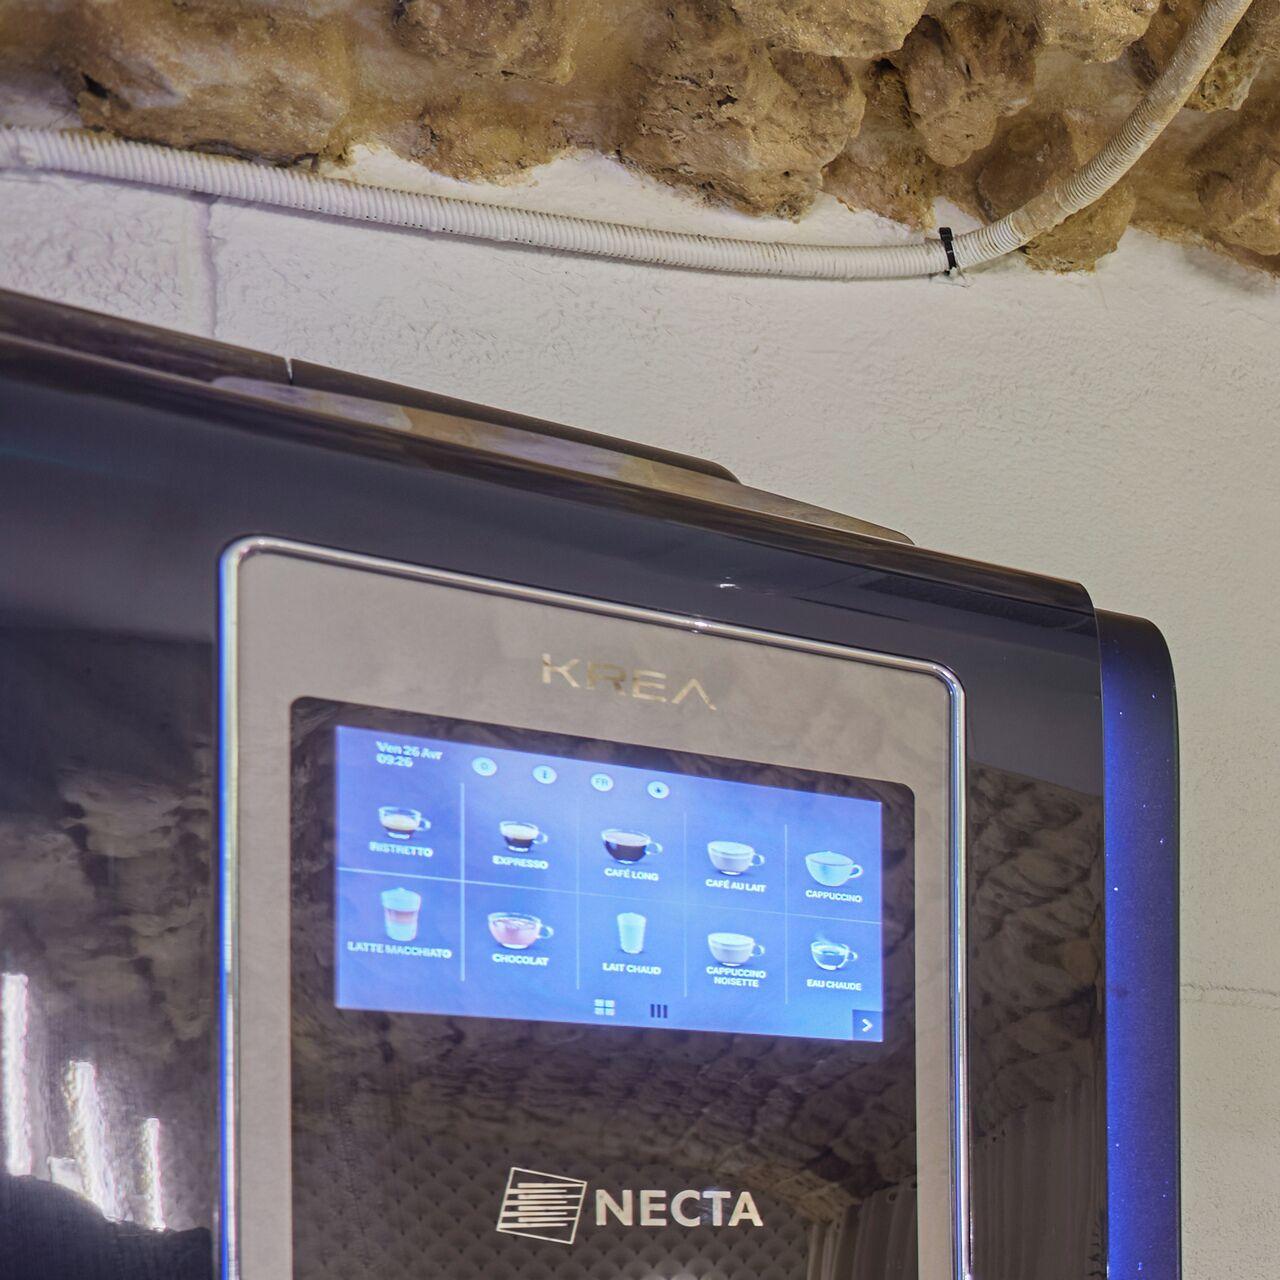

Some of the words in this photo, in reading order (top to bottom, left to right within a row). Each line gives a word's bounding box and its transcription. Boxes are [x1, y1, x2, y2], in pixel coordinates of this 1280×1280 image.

[542, 653, 717, 711] KREA
[369, 841, 433, 857] RISTRETTO
[492, 855, 549, 870] EXPRESSO
[604, 867, 630, 879] CAFÉ
[631, 870, 659, 881] LONG
[705, 878, 730, 890] CAFÉ
[731, 881, 745, 891] AU
[745, 882, 767, 893] LAIT
[805, 889, 862, 903] CAPPUCCINO
[347, 941, 383, 954] LATTE
[384, 944, 452, 959] MACCHIATO
[492, 953, 549, 966] CHOCOLAT
[602, 962, 625, 973] LAIT
[626, 963, 662, 975] CHAUD
[706, 966, 767, 979] CAPPUCCINO
[714, 976, 760, 988] NOISETTE
[806, 978, 825, 989] EAU
[825, 979, 862, 991] CHAUDE
[595, 1189, 764, 1227] NECTA
